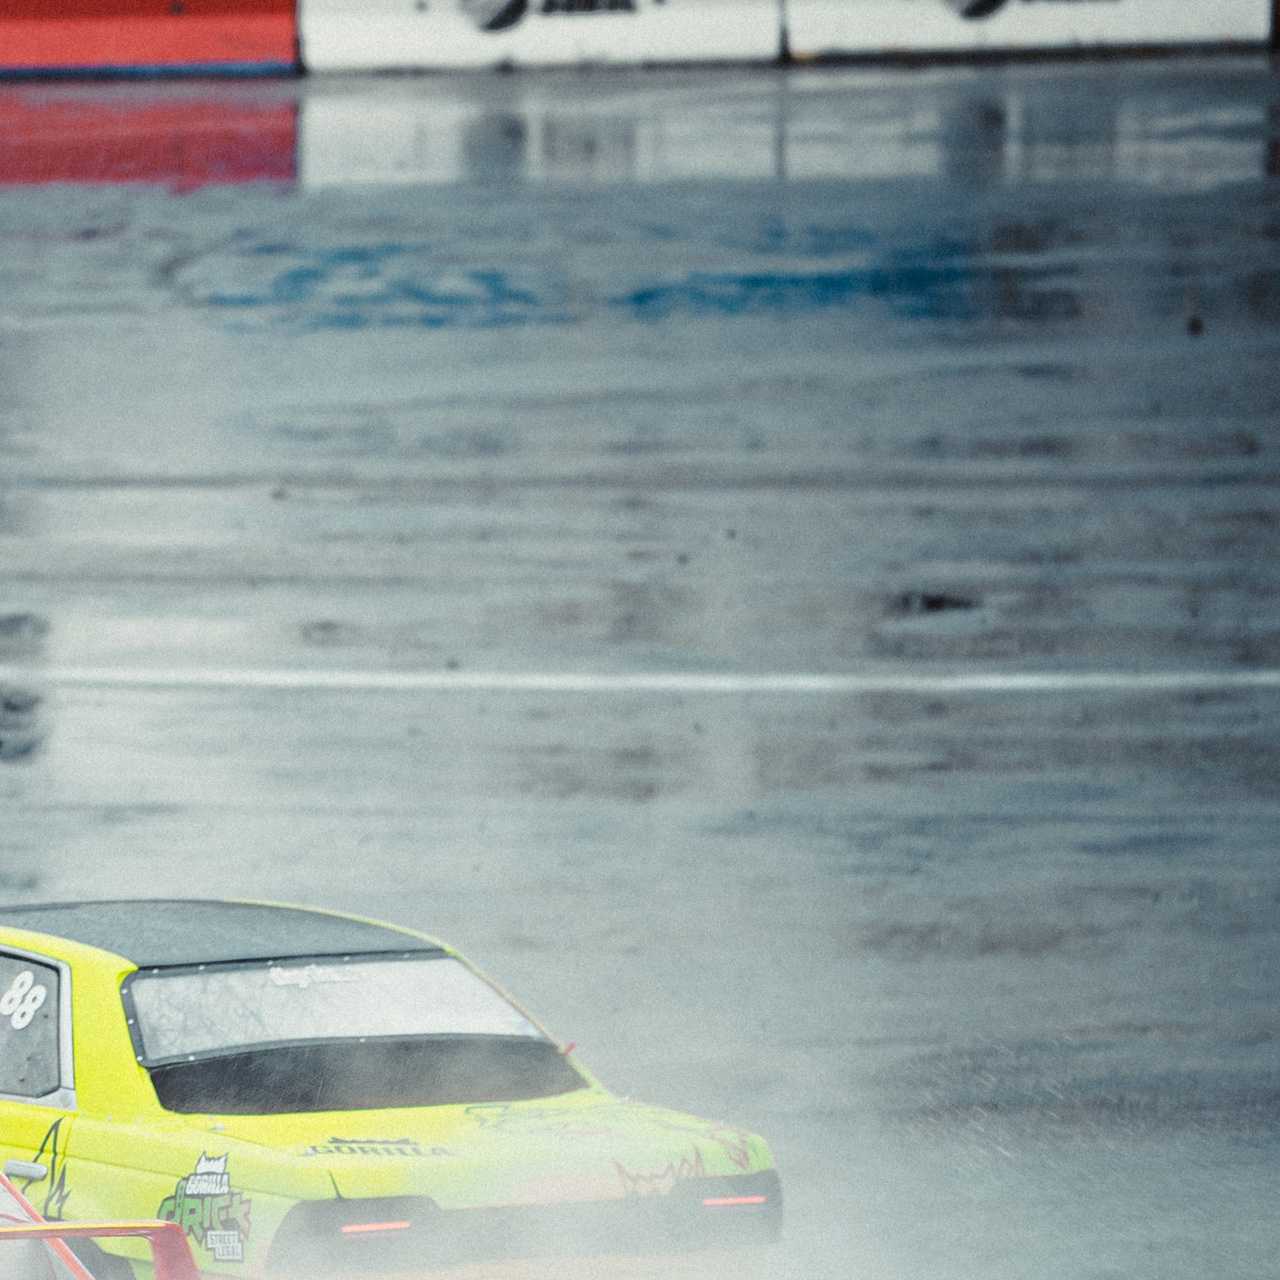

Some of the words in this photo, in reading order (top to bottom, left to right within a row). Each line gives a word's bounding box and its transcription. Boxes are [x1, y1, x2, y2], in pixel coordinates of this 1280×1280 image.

[0, 970, 47, 1030] 88
[186, 1173, 229, 1195] GORILLA
[209, 1233, 238, 1246] STREET
